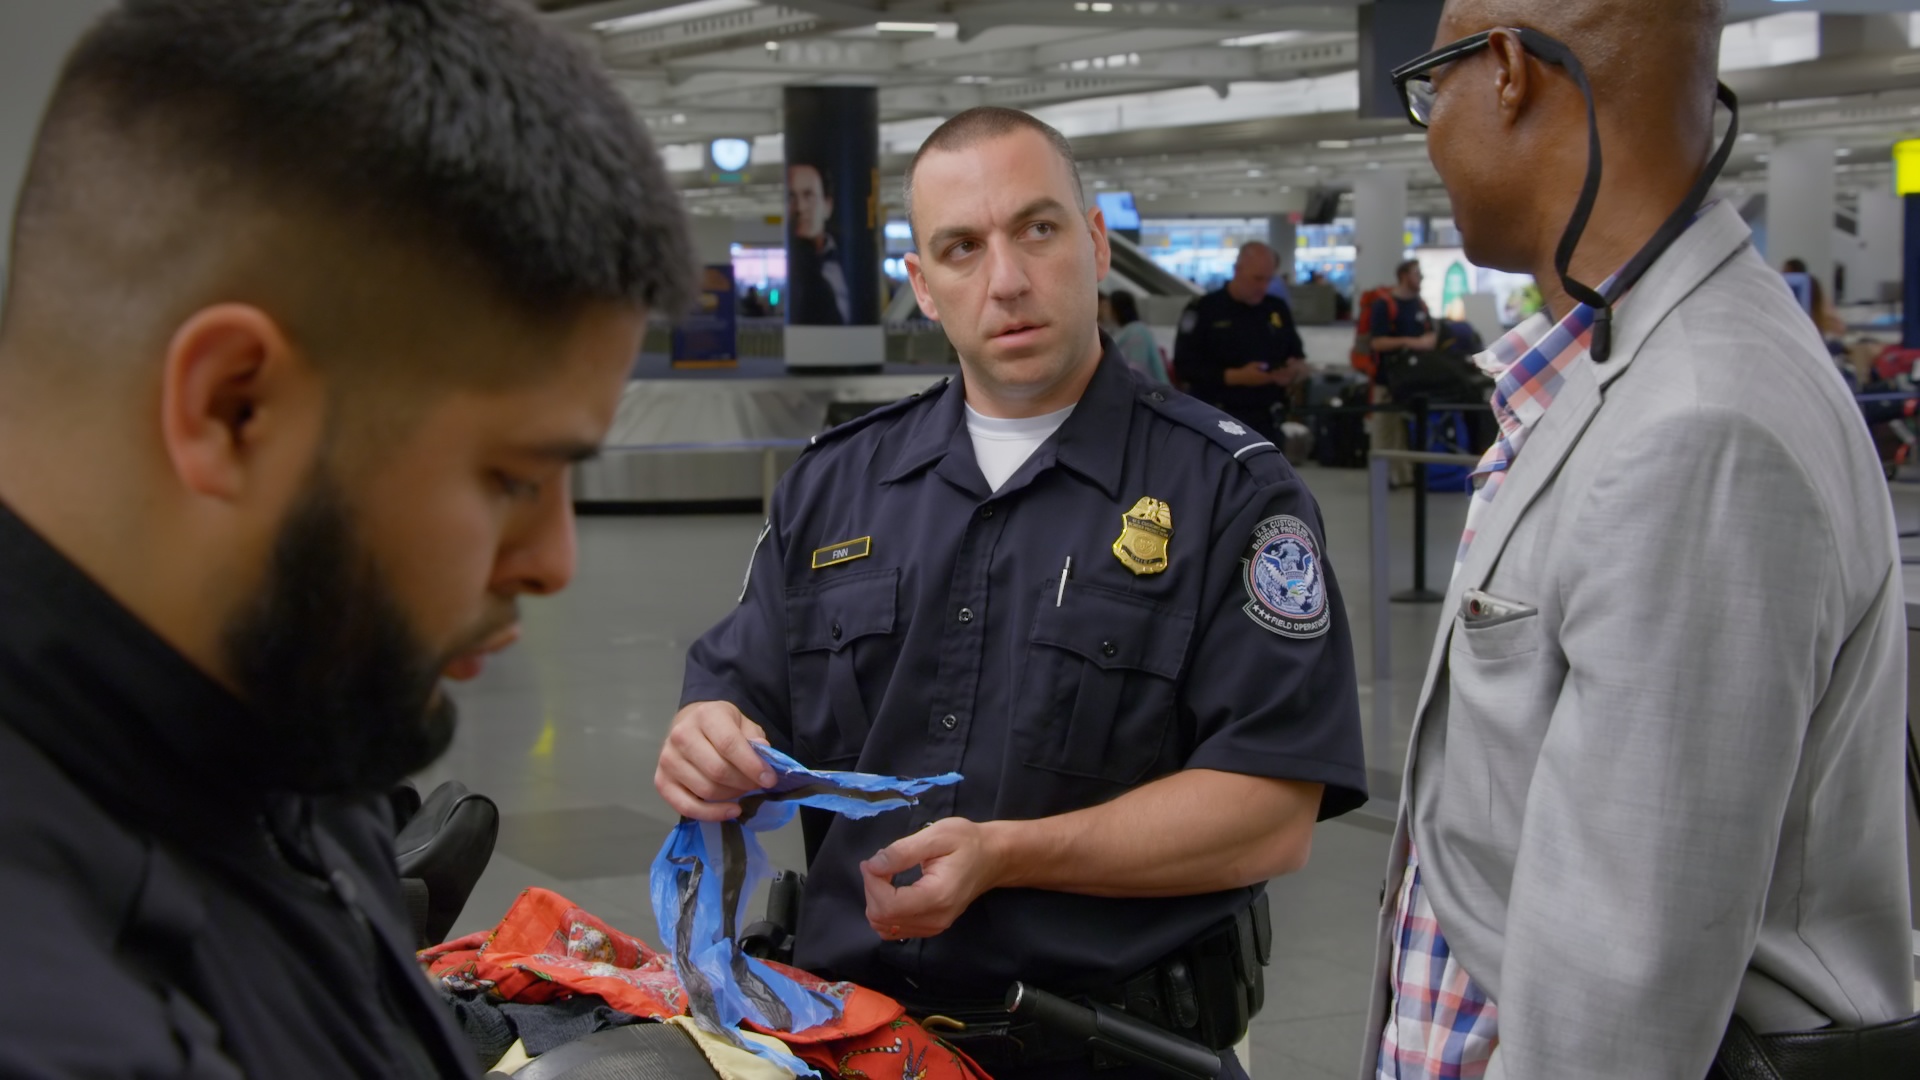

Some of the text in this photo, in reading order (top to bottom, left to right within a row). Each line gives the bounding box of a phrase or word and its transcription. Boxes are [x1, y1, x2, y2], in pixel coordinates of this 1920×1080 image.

[1254, 526, 1270, 537] U.S.
[1270, 520, 1300, 530] CUSTOMS
[1252, 528, 1279, 550] BORDER
[833, 548, 848, 559] FINN
[1270, 617, 1292, 629] FIELD
